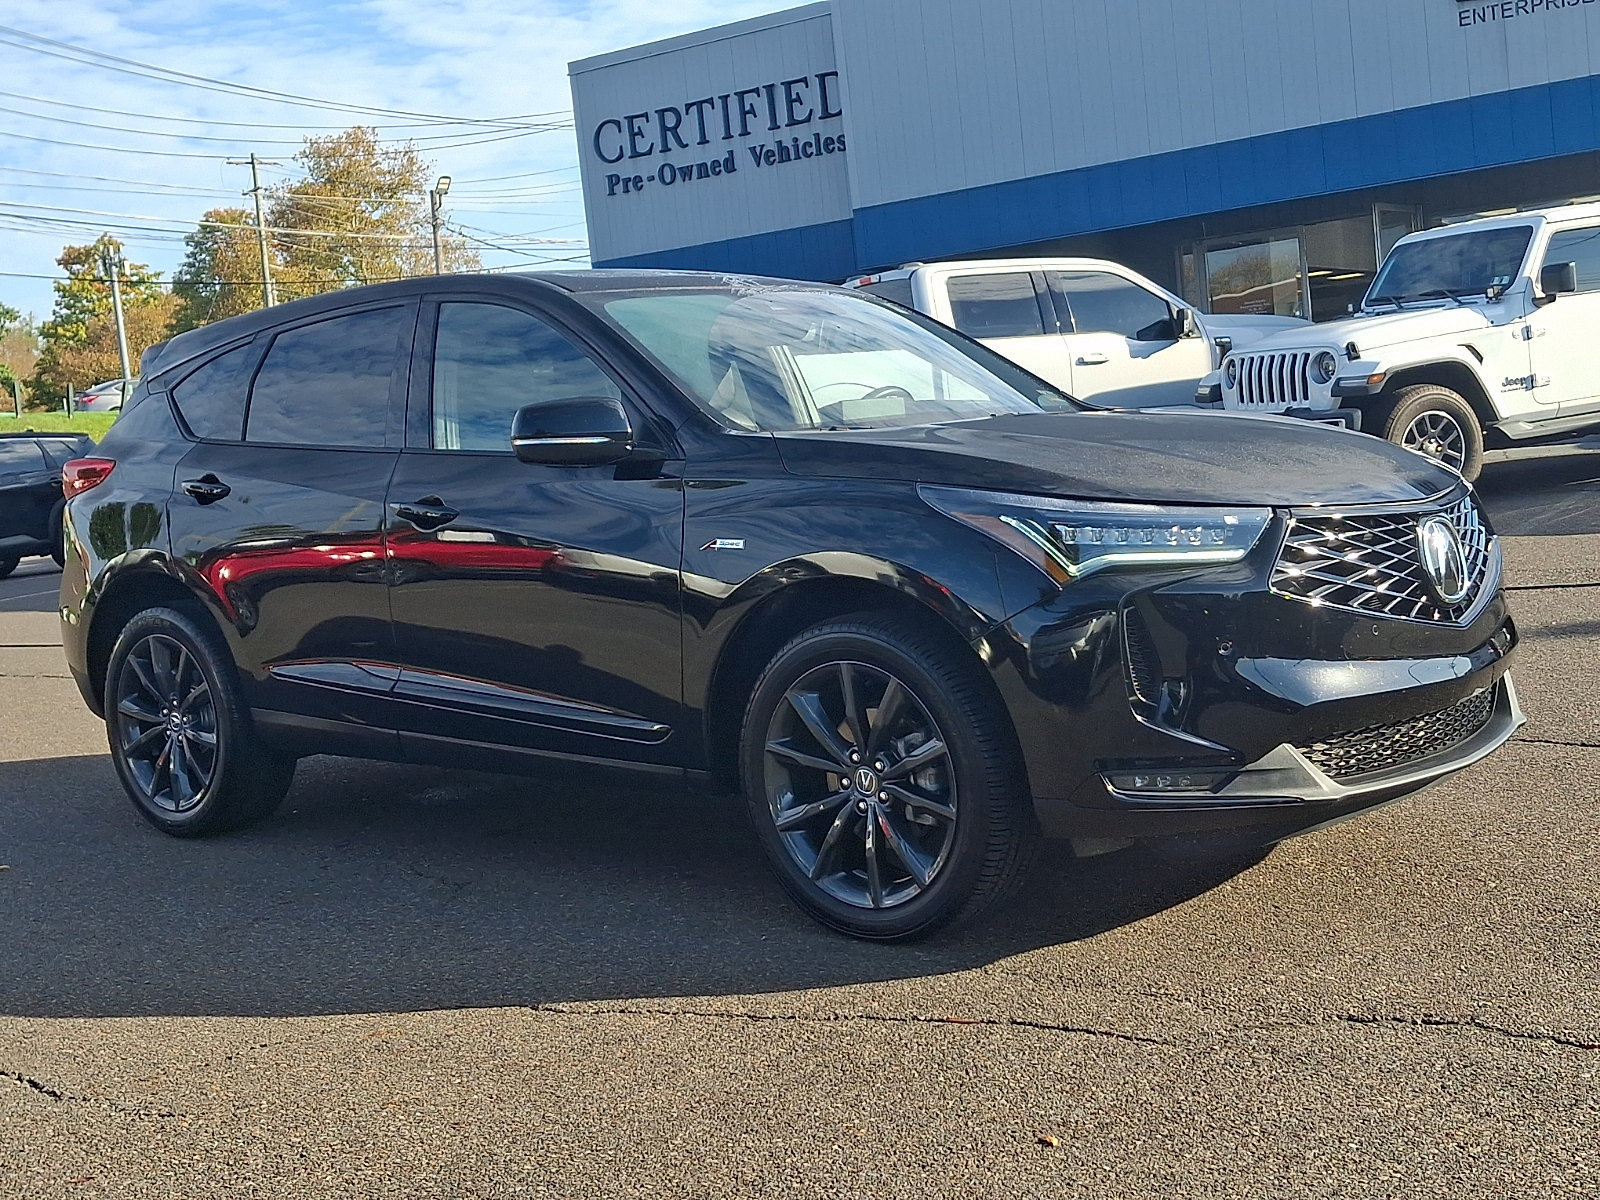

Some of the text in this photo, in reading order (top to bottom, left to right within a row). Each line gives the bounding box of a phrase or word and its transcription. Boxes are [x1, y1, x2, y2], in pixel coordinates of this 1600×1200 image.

[1458, 0, 1595, 27] ENTERPR
[605, 132, 846, 196] Pre-Owned Vehicles
[1501, 376, 1526, 387] Jeep
